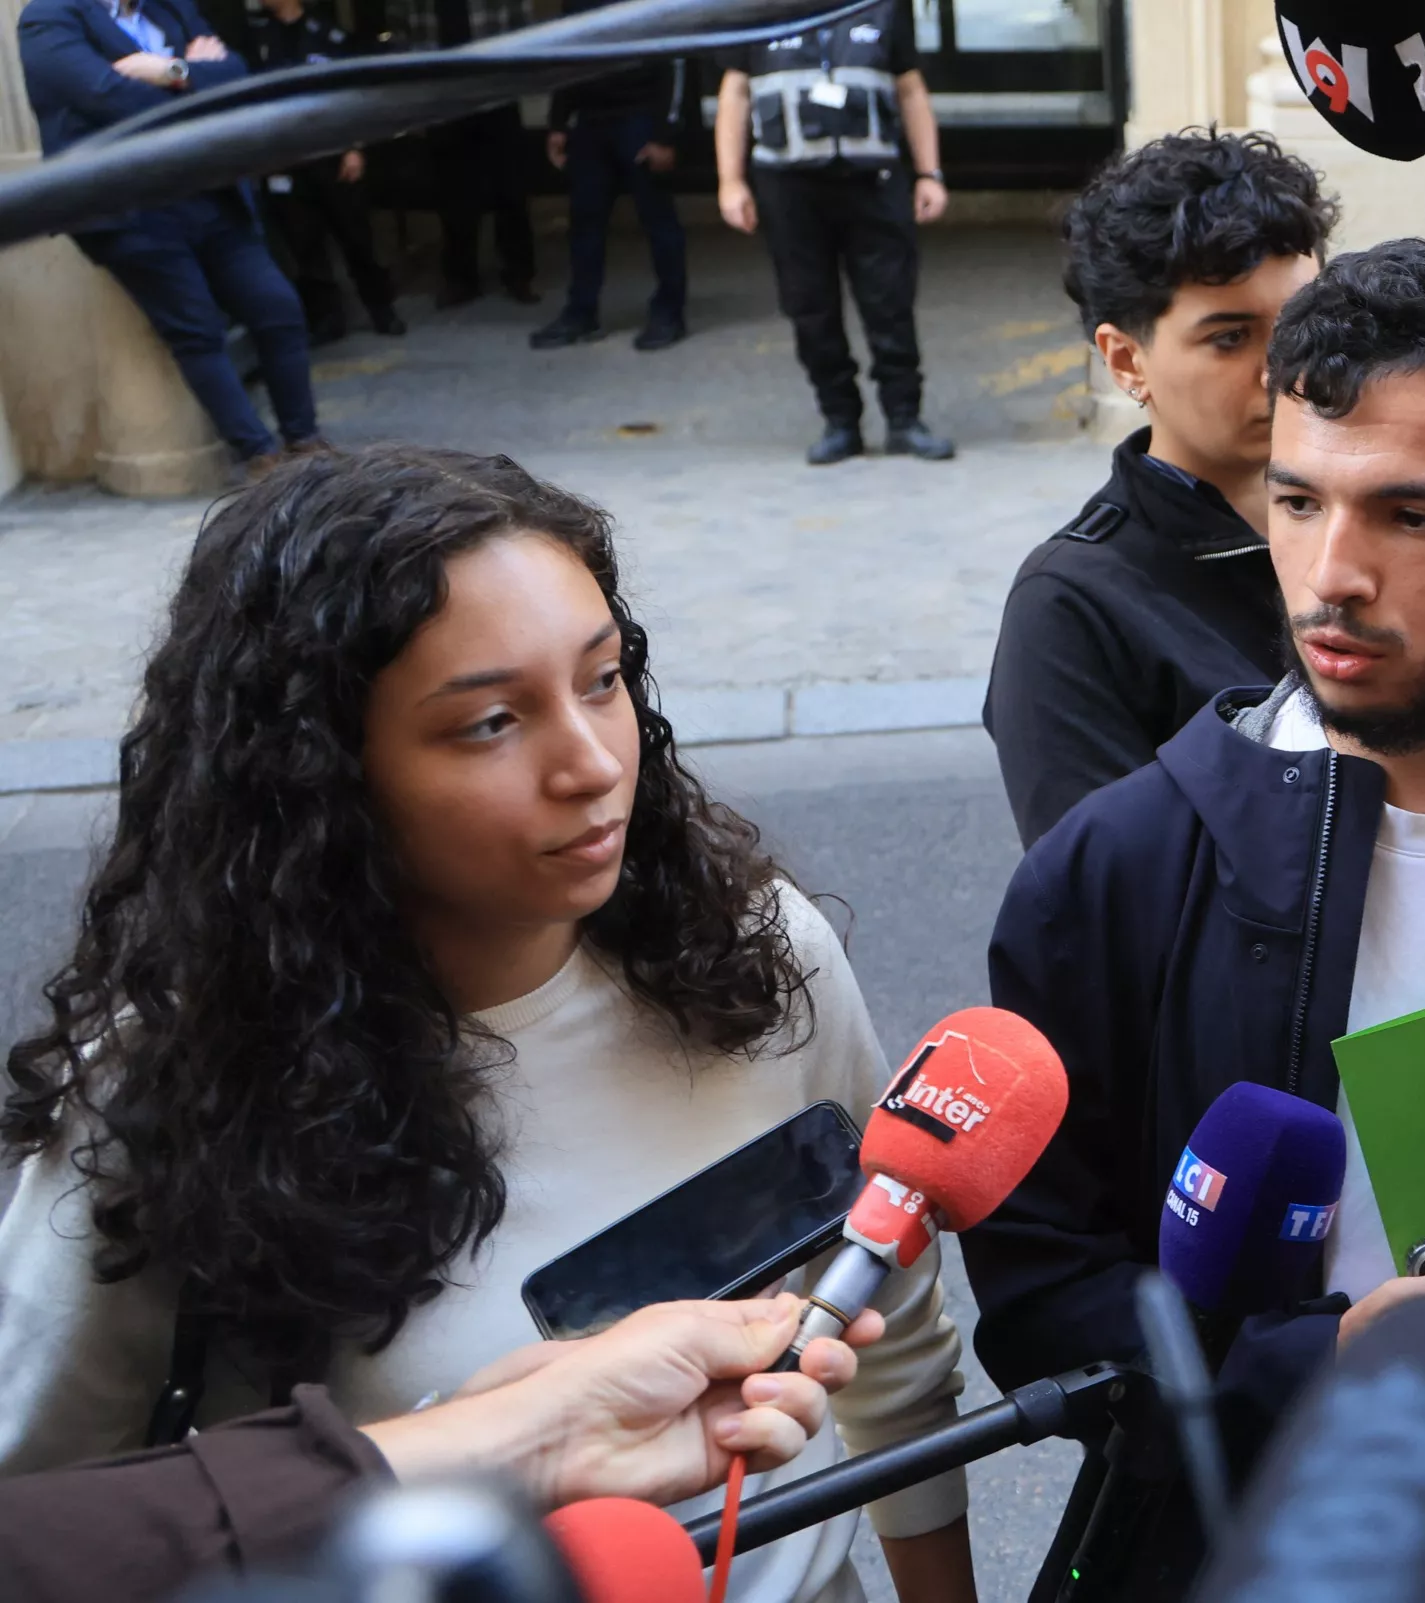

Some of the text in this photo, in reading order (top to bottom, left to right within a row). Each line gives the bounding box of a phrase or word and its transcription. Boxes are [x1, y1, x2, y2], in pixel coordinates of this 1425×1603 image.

[903, 1073, 987, 1133] inter
[1175, 1154, 1214, 1202] LCI
[1166, 1189, 1201, 1228] CANAL 15
